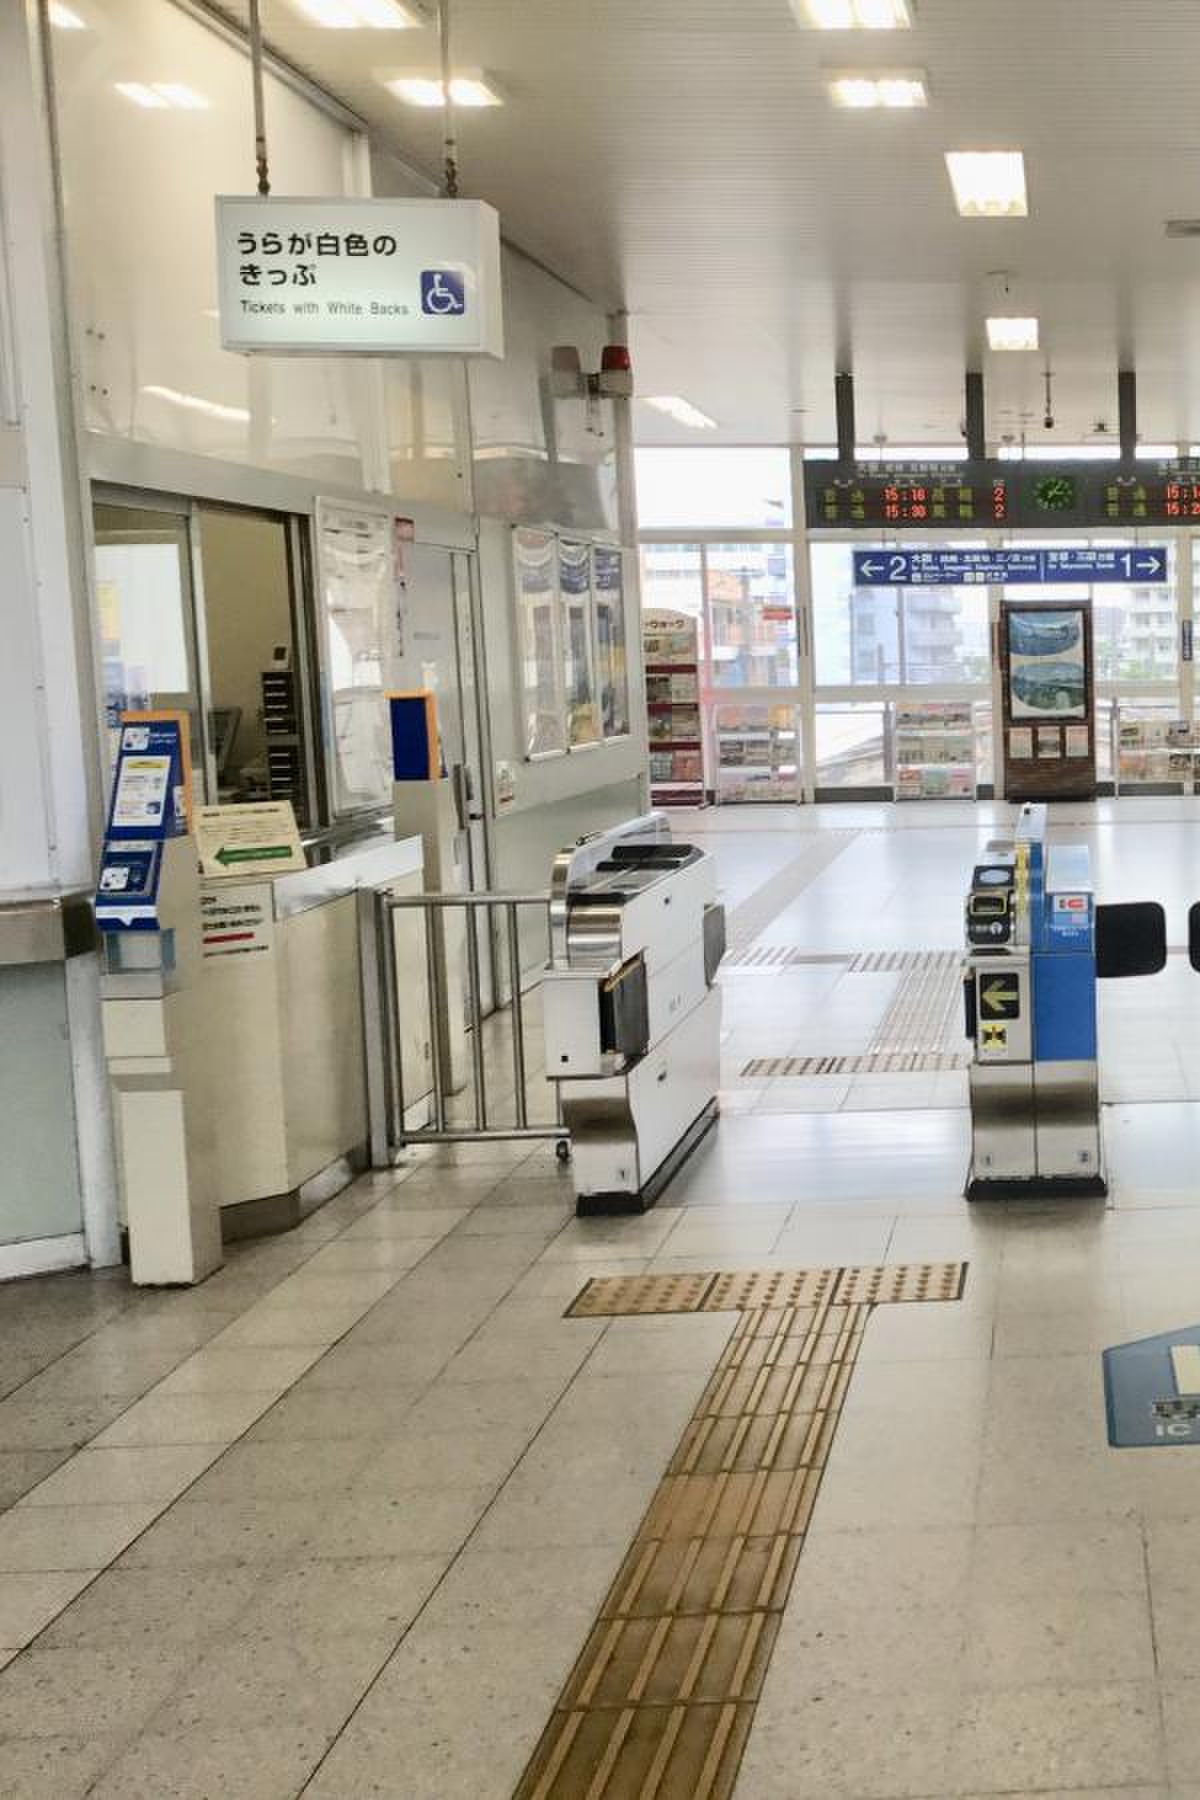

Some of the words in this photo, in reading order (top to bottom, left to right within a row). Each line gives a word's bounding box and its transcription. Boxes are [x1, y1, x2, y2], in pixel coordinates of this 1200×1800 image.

[237, 232, 397, 256] うらが白色の
[240, 263, 317, 286] きっぷ
[240, 300, 286, 314] Tickets
[294, 301, 319, 314] with
[328, 301, 362, 315] White
[371, 301, 409, 315] Backs
[993, 486, 1008, 500] 2
[993, 502, 1008, 519] 2
[889, 555, 907, 581] 2
[1120, 553, 1132, 577] 1
[1155, 1423, 1192, 1437] IC
